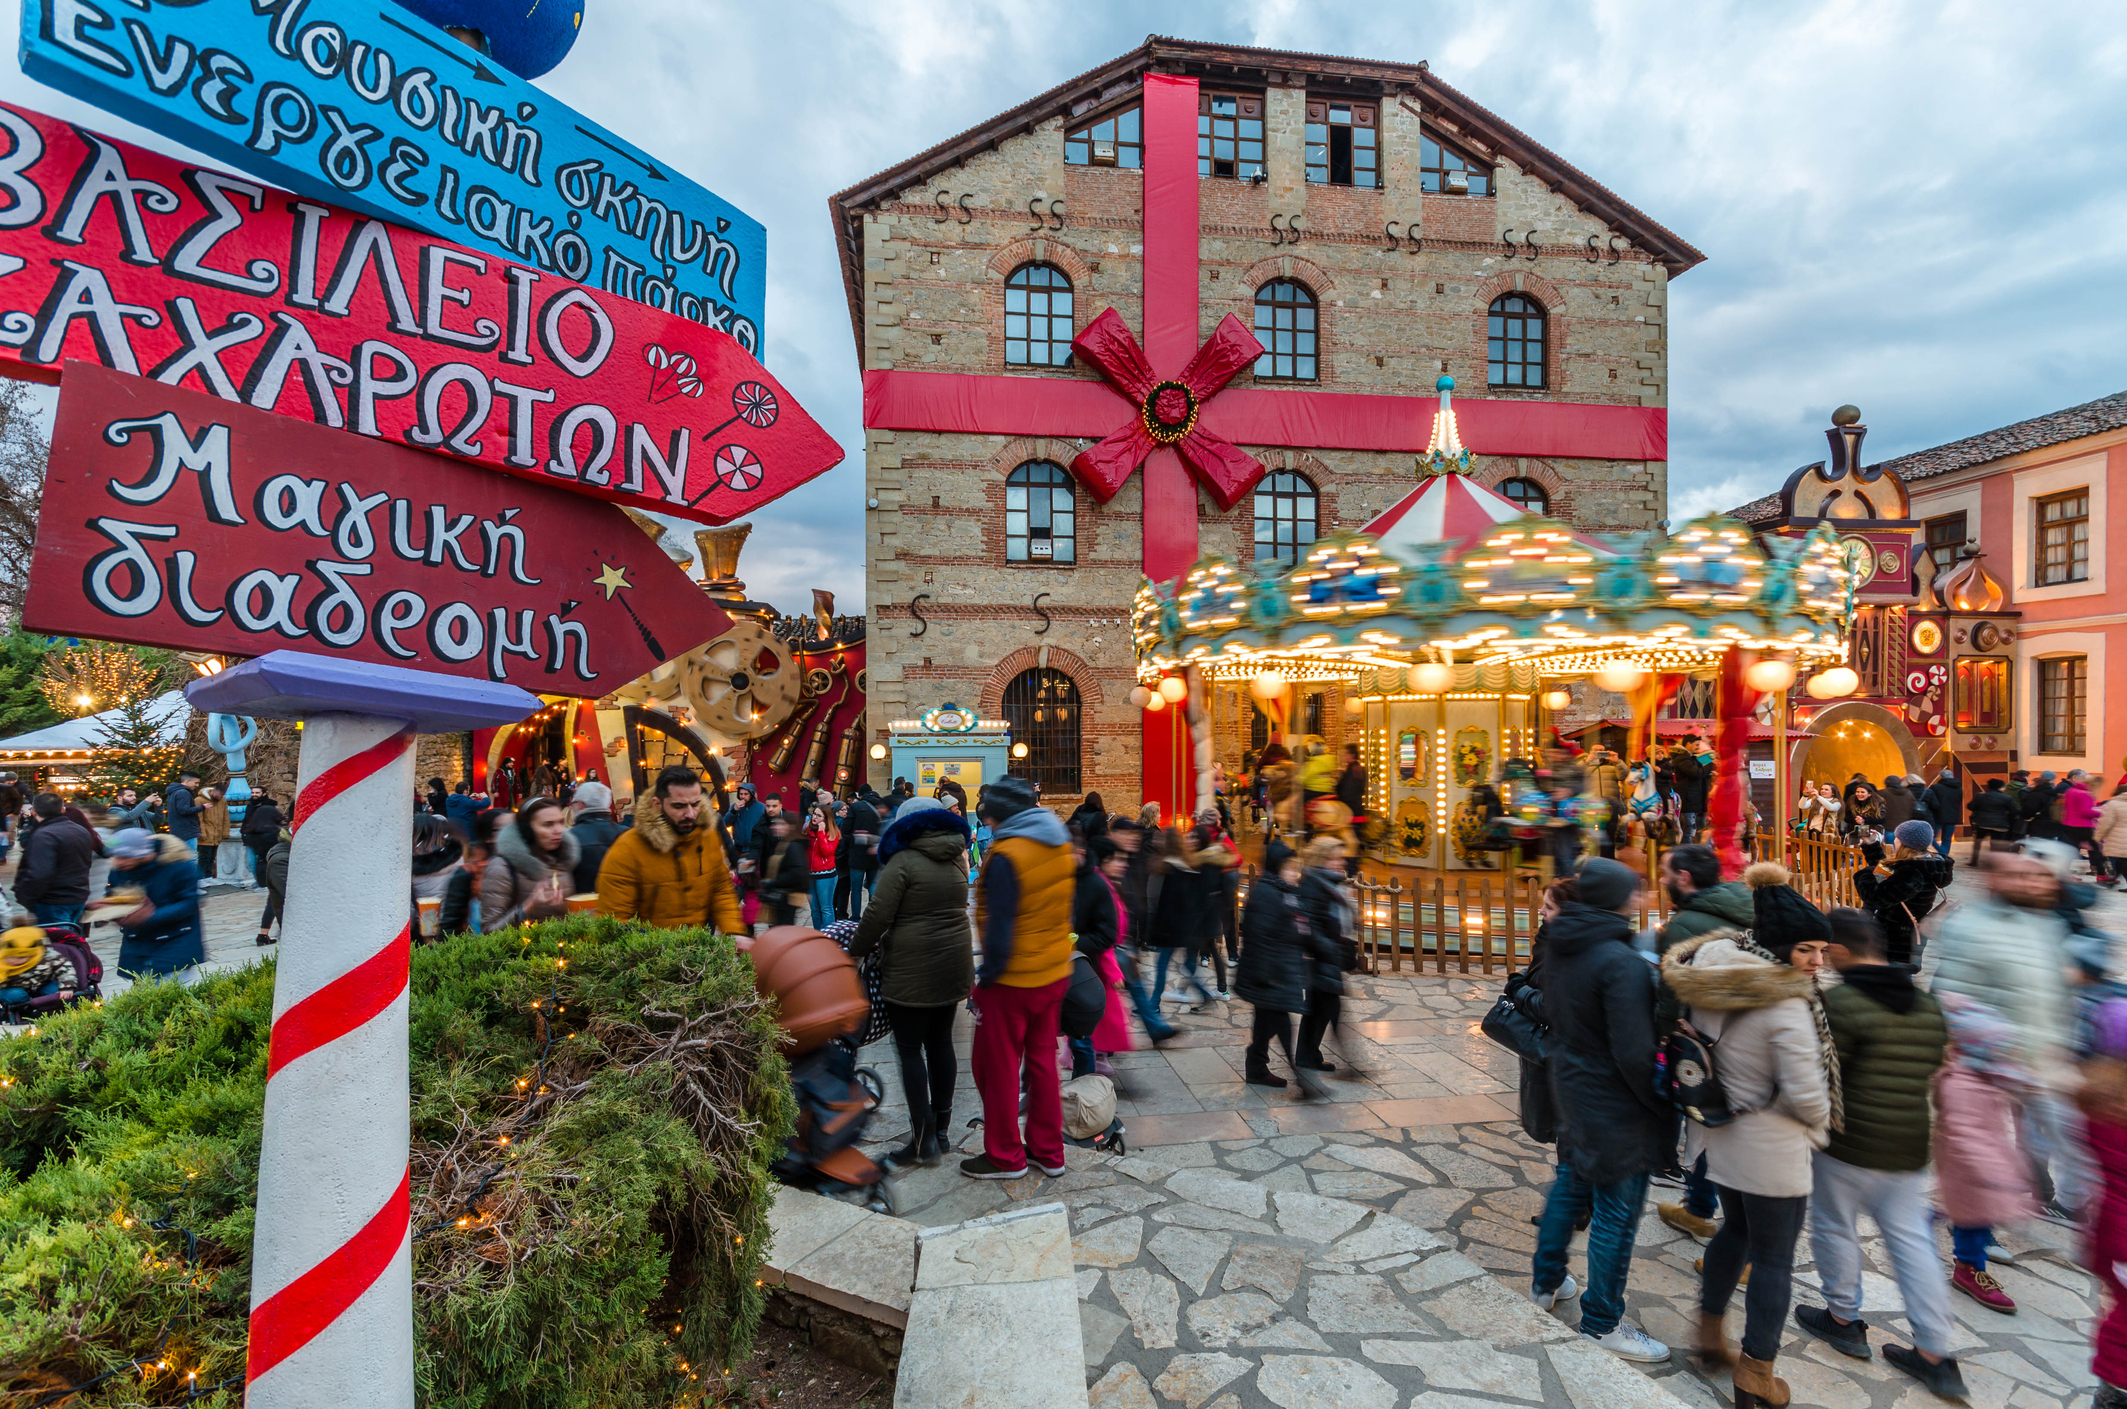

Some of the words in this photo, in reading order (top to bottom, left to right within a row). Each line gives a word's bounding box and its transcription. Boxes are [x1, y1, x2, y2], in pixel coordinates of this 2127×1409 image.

[40, 0, 592, 283] Ενεργειακό
[555, 158, 740, 303] σκηνή
[101, 410, 543, 584] Μαγική
[83, 516, 600, 682] διαδρομή
